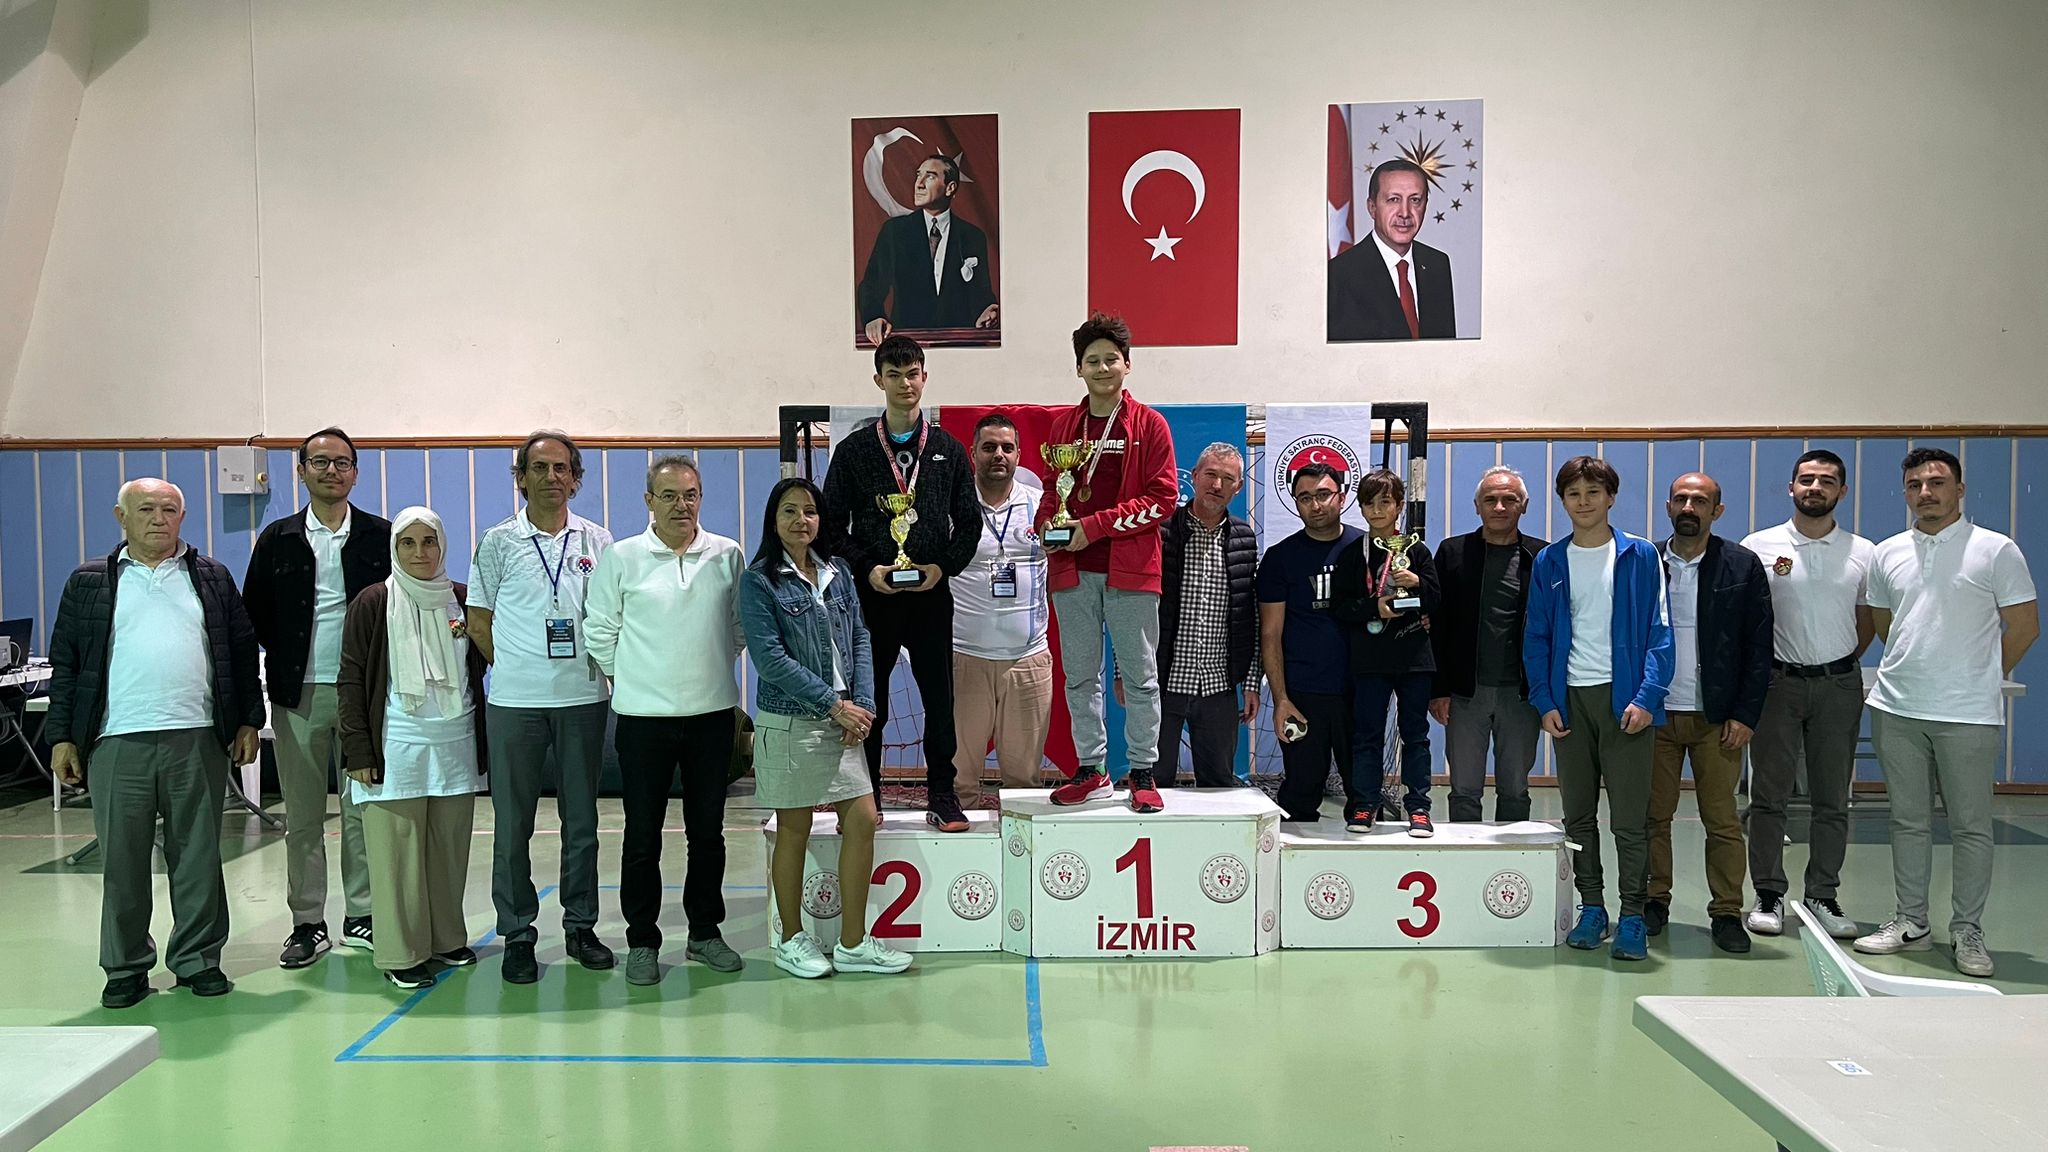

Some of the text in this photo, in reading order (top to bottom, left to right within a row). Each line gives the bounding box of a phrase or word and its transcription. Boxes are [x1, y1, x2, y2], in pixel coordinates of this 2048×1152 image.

[1277, 438, 1359, 492] TÜRKİYE SATRANÇ FEDERASYONU
[870, 861, 922, 938] 2
[1116, 838, 1153, 919] 1
[1397, 871, 1440, 938] 3
[1097, 915, 1197, 950] İZMİR
